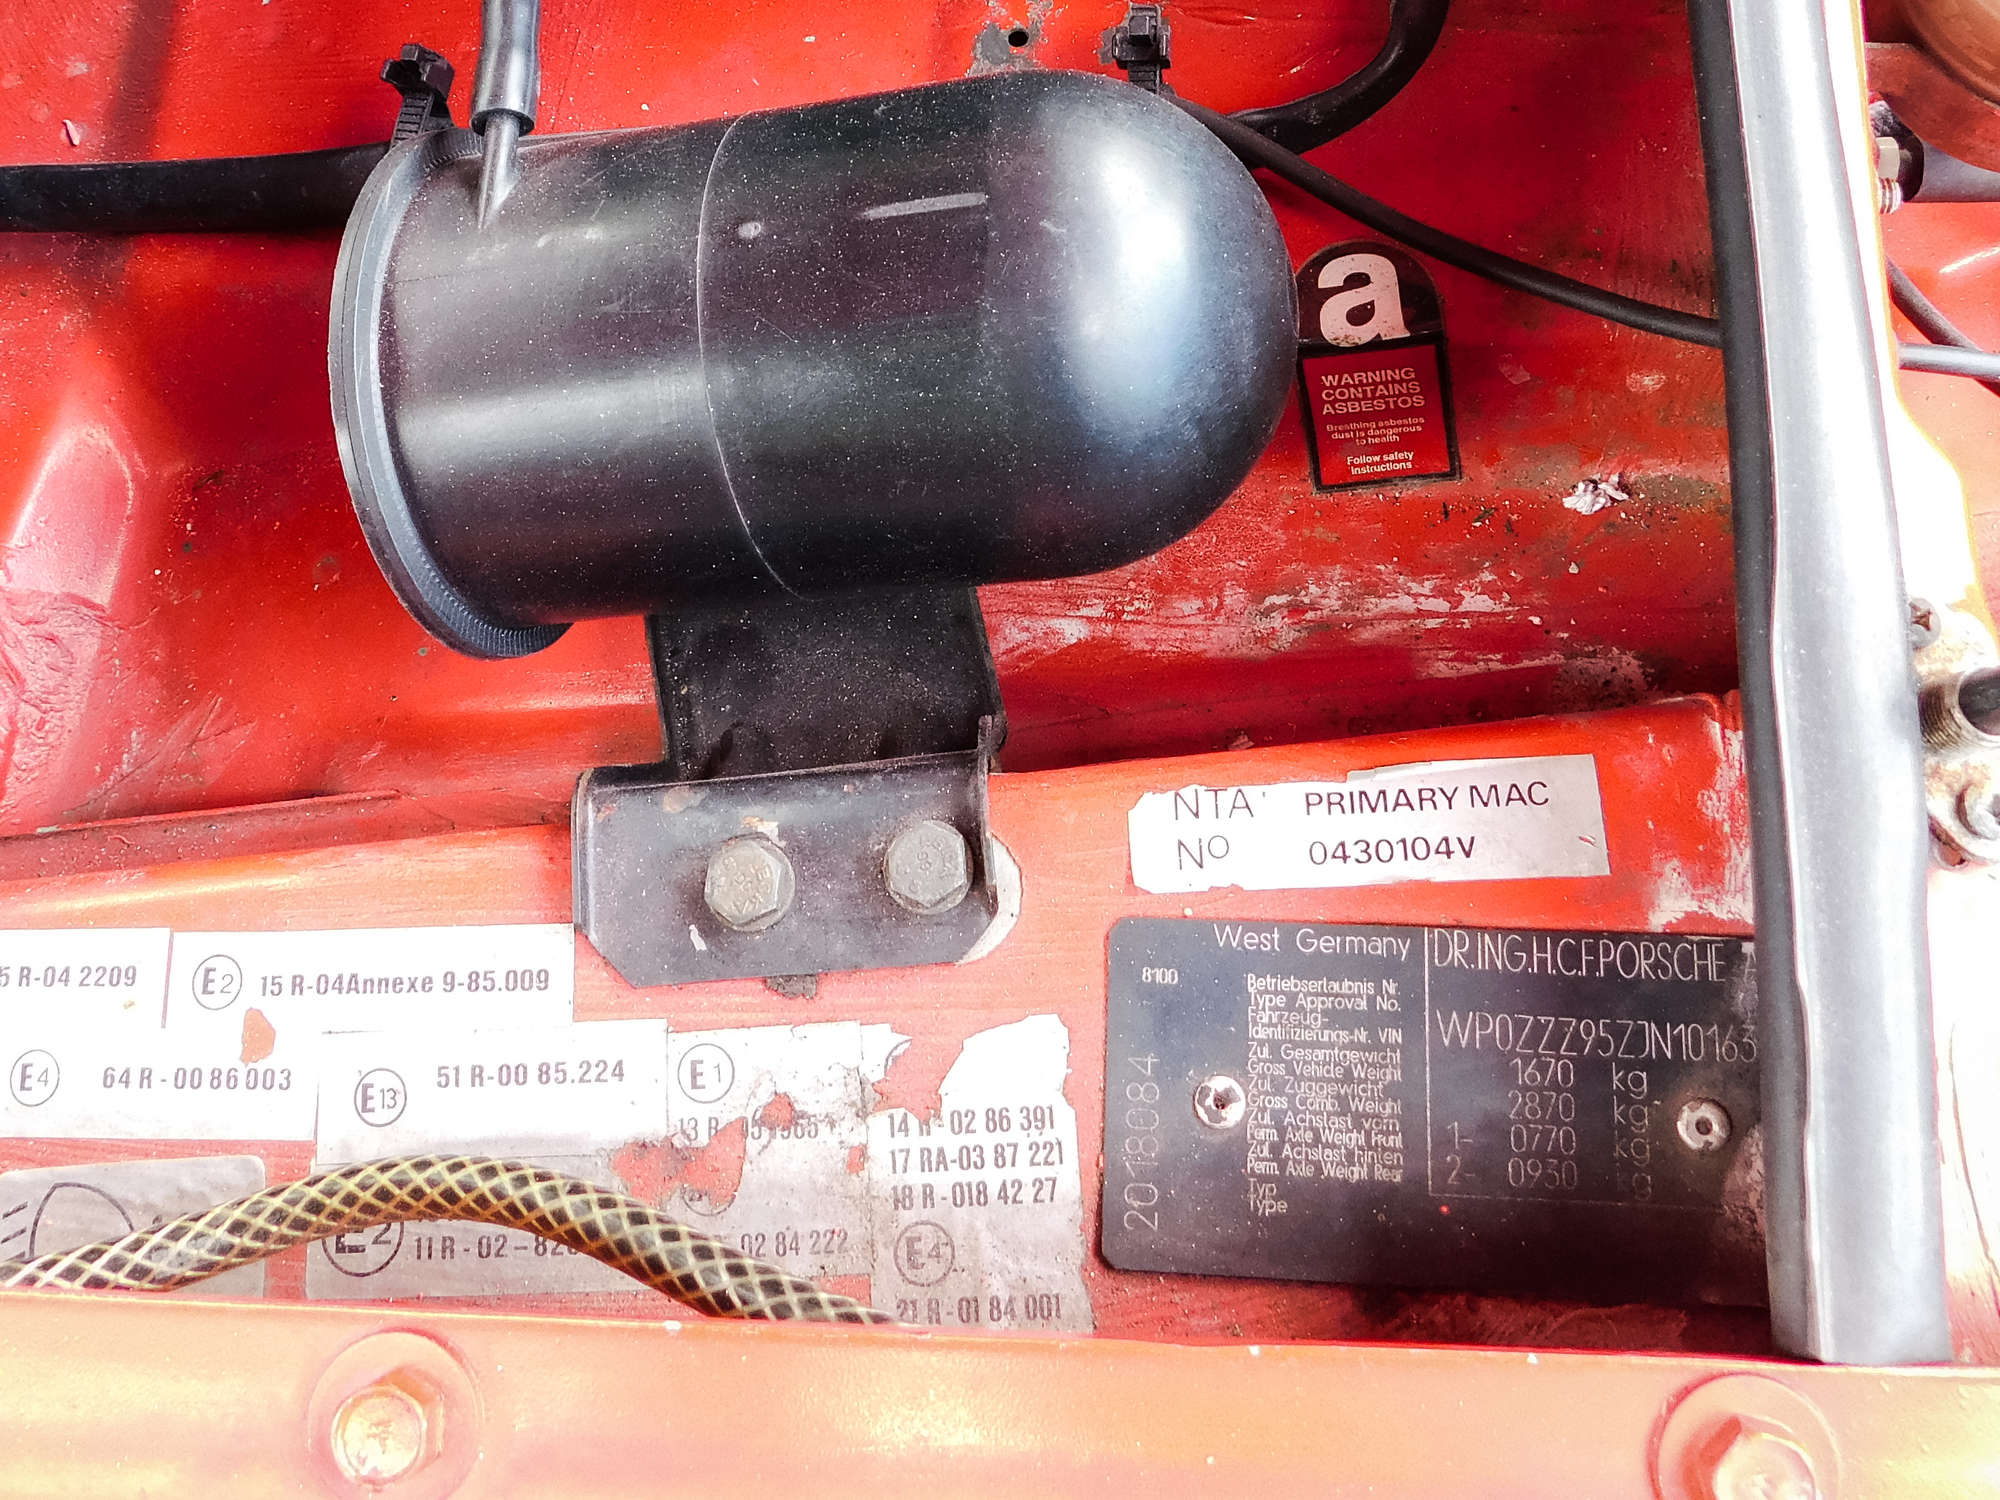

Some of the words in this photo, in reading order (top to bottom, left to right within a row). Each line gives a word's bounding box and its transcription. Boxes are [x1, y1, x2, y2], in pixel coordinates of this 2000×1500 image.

[1318, 253, 1411, 347] a
[1321, 368, 1415, 386] WARNING
[1321, 381, 1420, 401] CONTAINS
[1322, 395, 1425, 415] ASBESTOS
[1326, 421, 1377, 432] Breathing
[1378, 417, 1425, 426] asbestos
[1331, 431, 1354, 439] dust
[1367, 425, 1422, 437] dangerous
[1368, 434, 1400, 445] health
[1347, 454, 1380, 465] Follow
[1383, 450, 1414, 460] safety
[1174, 788, 1254, 821] NTA
[1305, 785, 1459, 816] PRIMARY
[1470, 780, 1549, 808] MAC
[1309, 835, 1475, 866] 0430104V
[1214, 923, 1280, 952] West
[1296, 928, 1410, 961] Germany
[18, 965, 70, 987] R-04
[78, 965, 137, 988] 2209
[260, 976, 283, 997] 15
[442, 969, 550, 993] 9-85.009
[1142, 967, 1178, 985] 8100
[1247, 973, 1374, 995] Betriebserlaubnis
[1382, 979, 1401, 995] Nr.
[1249, 990, 1286, 1011] Type
[1295, 992, 1367, 1012] Approval
[1377, 995, 1401, 1012] No.
[1248, 1007, 1328, 1028] Fahrzeug-
[1249, 1023, 1371, 1047] Identifizierungs-Nr.
[1378, 1027, 1402, 1045] VIN
[1248, 1042, 1272, 1059] Zul.
[1281, 1044, 1401, 1066] Gesamtgewicht
[102, 1066, 131, 1089] 64
[437, 1065, 460, 1088] 51
[470, 1063, 528, 1087] R-00
[537, 1059, 625, 1084] 85.224
[1248, 1058, 1285, 1075] Gross
[1293, 1061, 1344, 1078] Vehicle
[1351, 1063, 1402, 1085] Weight
[1509, 1057, 1574, 1087] 1670
[1612, 1062, 1648, 1099] kg
[1248, 1075, 1275, 1092] Zul.
[1284, 1076, 1384, 1098] Zuggewicht
[1248, 1092, 1288, 1108] Gross
[1296, 1094, 1341, 1112] Comb.
[1349, 1097, 1402, 1117] Weight
[1508, 1090, 1576, 1122] 2870
[1613, 1095, 1649, 1133] kg
[888, 1112, 909, 1138] 14
[985, 1107, 1011, 1133] 86
[1020, 1104, 1055, 1131] 391
[1248, 1108, 1274, 1125] Zul.
[1284, 1111, 1352, 1128] Achslast
[1362, 1117, 1400, 1131] vorn
[1247, 1125, 1279, 1142] Perm.
[1285, 1126, 1313, 1142] Axle
[1320, 1128, 1366, 1148] Weight
[1510, 1124, 1576, 1155] 0770
[1614, 1130, 1650, 1166] kg
[890, 1148, 911, 1174] 17
[920, 1144, 985, 1172] RA-03
[994, 1142, 1018, 1168] 87
[1028, 1138, 1063, 1167] 221
[1248, 1140, 1273, 1158] Zul.
[1282, 1143, 1346, 1161] Achslast
[1355, 1148, 1403, 1165] hinten
[1247, 1158, 1280, 1175] Perm.
[1286, 1160, 1314, 1177] Axle
[1321, 1162, 1368, 1183] Weight
[1374, 1165, 1403, 1183] Rear
[1508, 1157, 1577, 1189] 0930
[891, 1184, 914, 1211] 18
[997, 1179, 1023, 1205] 42
[1032, 1177, 1057, 1203] 27
[1248, 1178, 1277, 1199] Typ
[1247, 1195, 1289, 1217] Type
[740, 1233, 767, 1258] 02
[775, 1231, 800, 1258] 84
[809, 1228, 848, 1255] 222
[989, 1295, 1016, 1322] 84
[1024, 1293, 1061, 1321] 001
